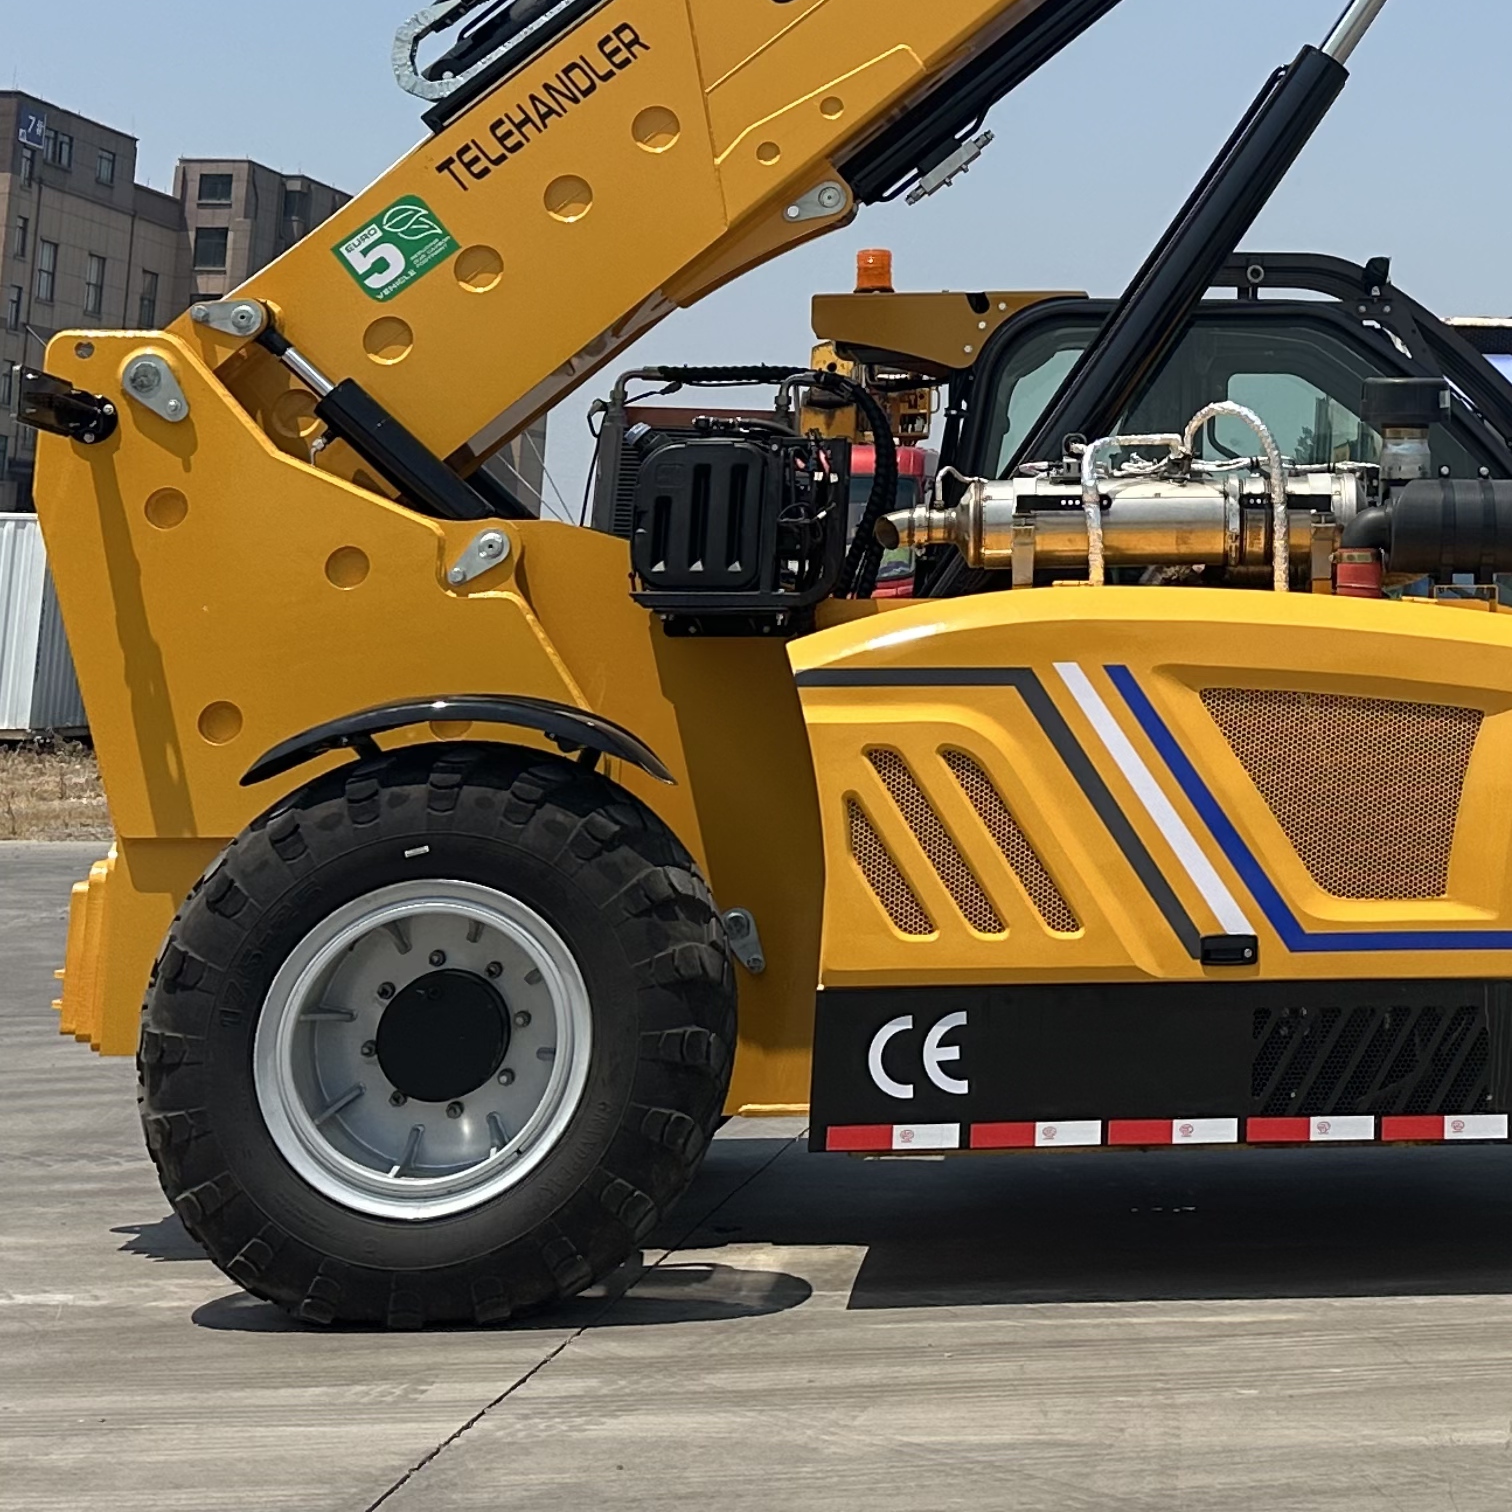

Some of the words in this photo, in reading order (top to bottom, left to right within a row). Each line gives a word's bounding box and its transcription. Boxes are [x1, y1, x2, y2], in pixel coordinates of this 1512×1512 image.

[434, 22, 651, 192] TELEHANDLER
[340, 223, 406, 288] 5
[344, 227, 378, 253] EURO
[376, 268, 417, 299] VEHICLE
[867, 1010, 969, 1099] CE
